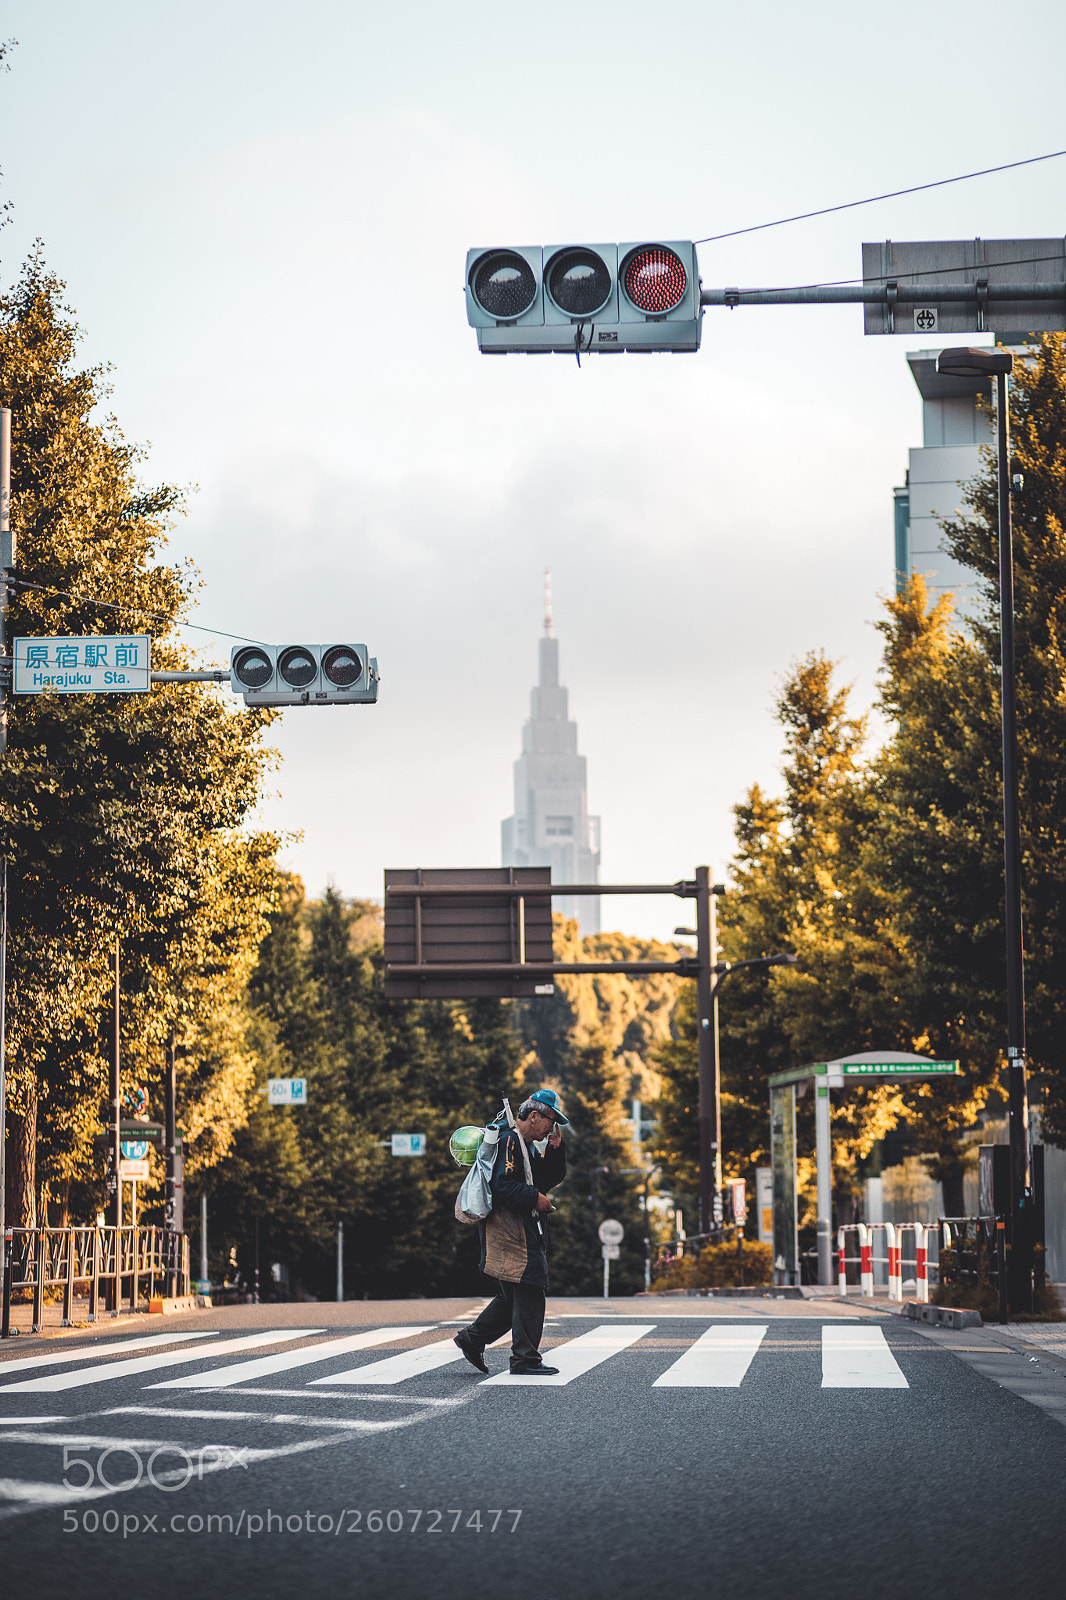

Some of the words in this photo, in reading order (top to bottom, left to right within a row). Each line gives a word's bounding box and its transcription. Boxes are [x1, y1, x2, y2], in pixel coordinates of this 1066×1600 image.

[25, 643, 139, 669] 原宿駅前
[33, 672, 92, 687] Harajuku
[104, 671, 130, 684] Sta.
